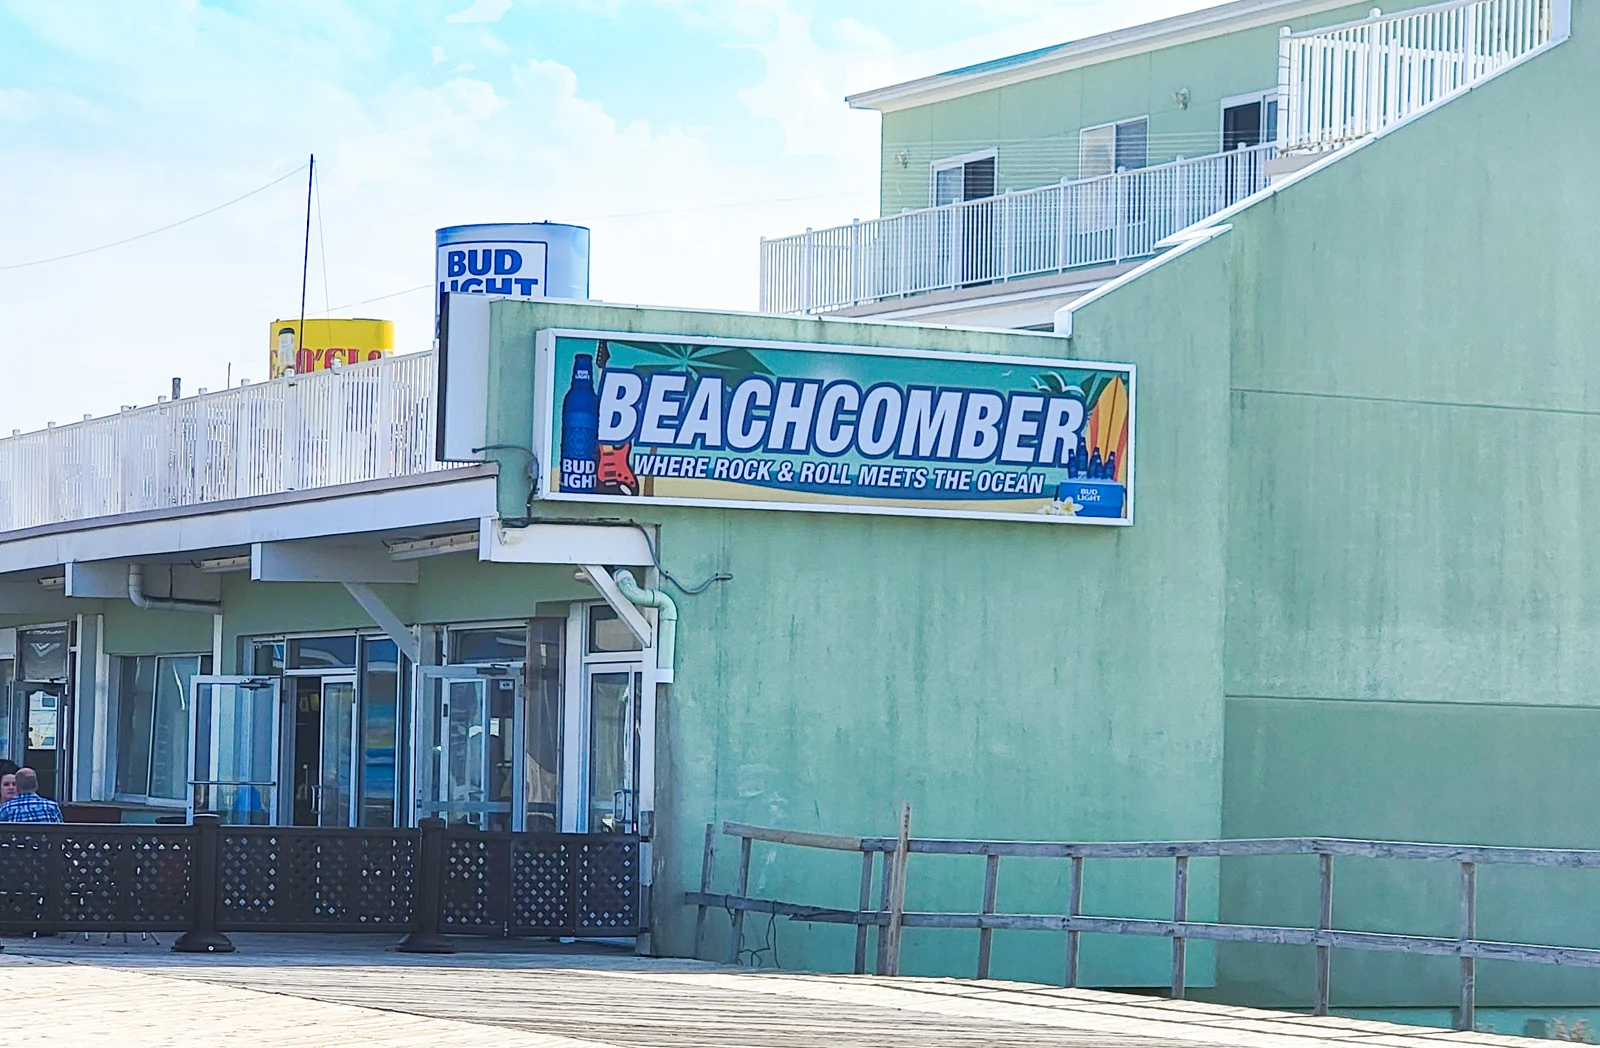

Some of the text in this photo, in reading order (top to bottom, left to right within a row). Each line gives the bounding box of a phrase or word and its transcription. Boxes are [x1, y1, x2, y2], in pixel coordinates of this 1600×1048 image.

[448, 249, 522, 277] BUD
[597, 369, 1086, 467] BEACHCOMBER
[562, 458, 596, 474] BUD
[634, 454, 1046, 494] WHERE ROCK & ROLL MEETS THE OCEAN
[560, 473, 597, 489] IGH
[1077, 494, 1101, 502] LIGHT
